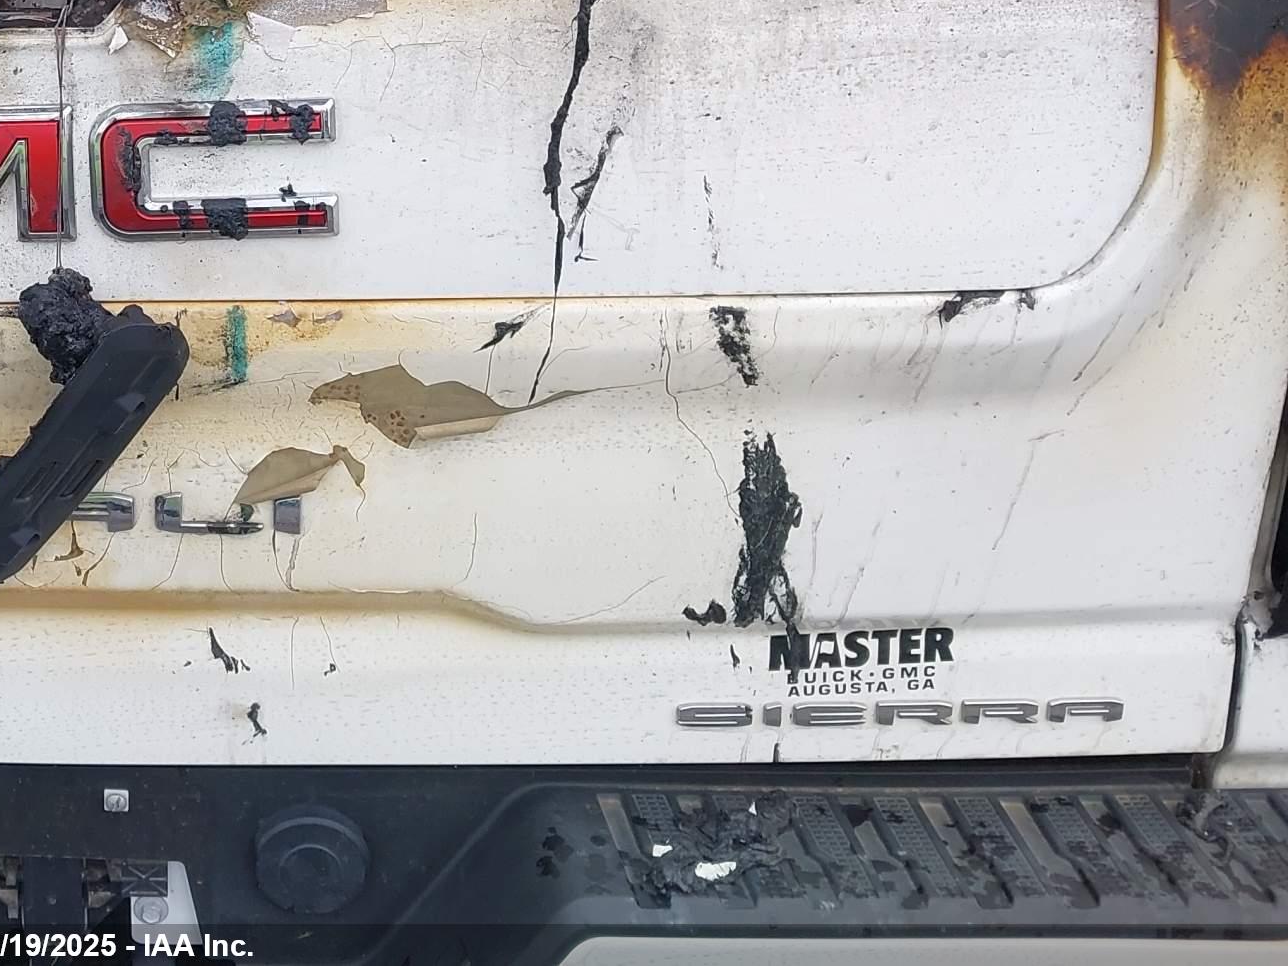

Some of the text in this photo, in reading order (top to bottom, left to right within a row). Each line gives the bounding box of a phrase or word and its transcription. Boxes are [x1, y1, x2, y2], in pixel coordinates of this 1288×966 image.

[787, 678, 935, 697] AUGUSTA, GA
[676, 697, 1124, 726] SIERRA
